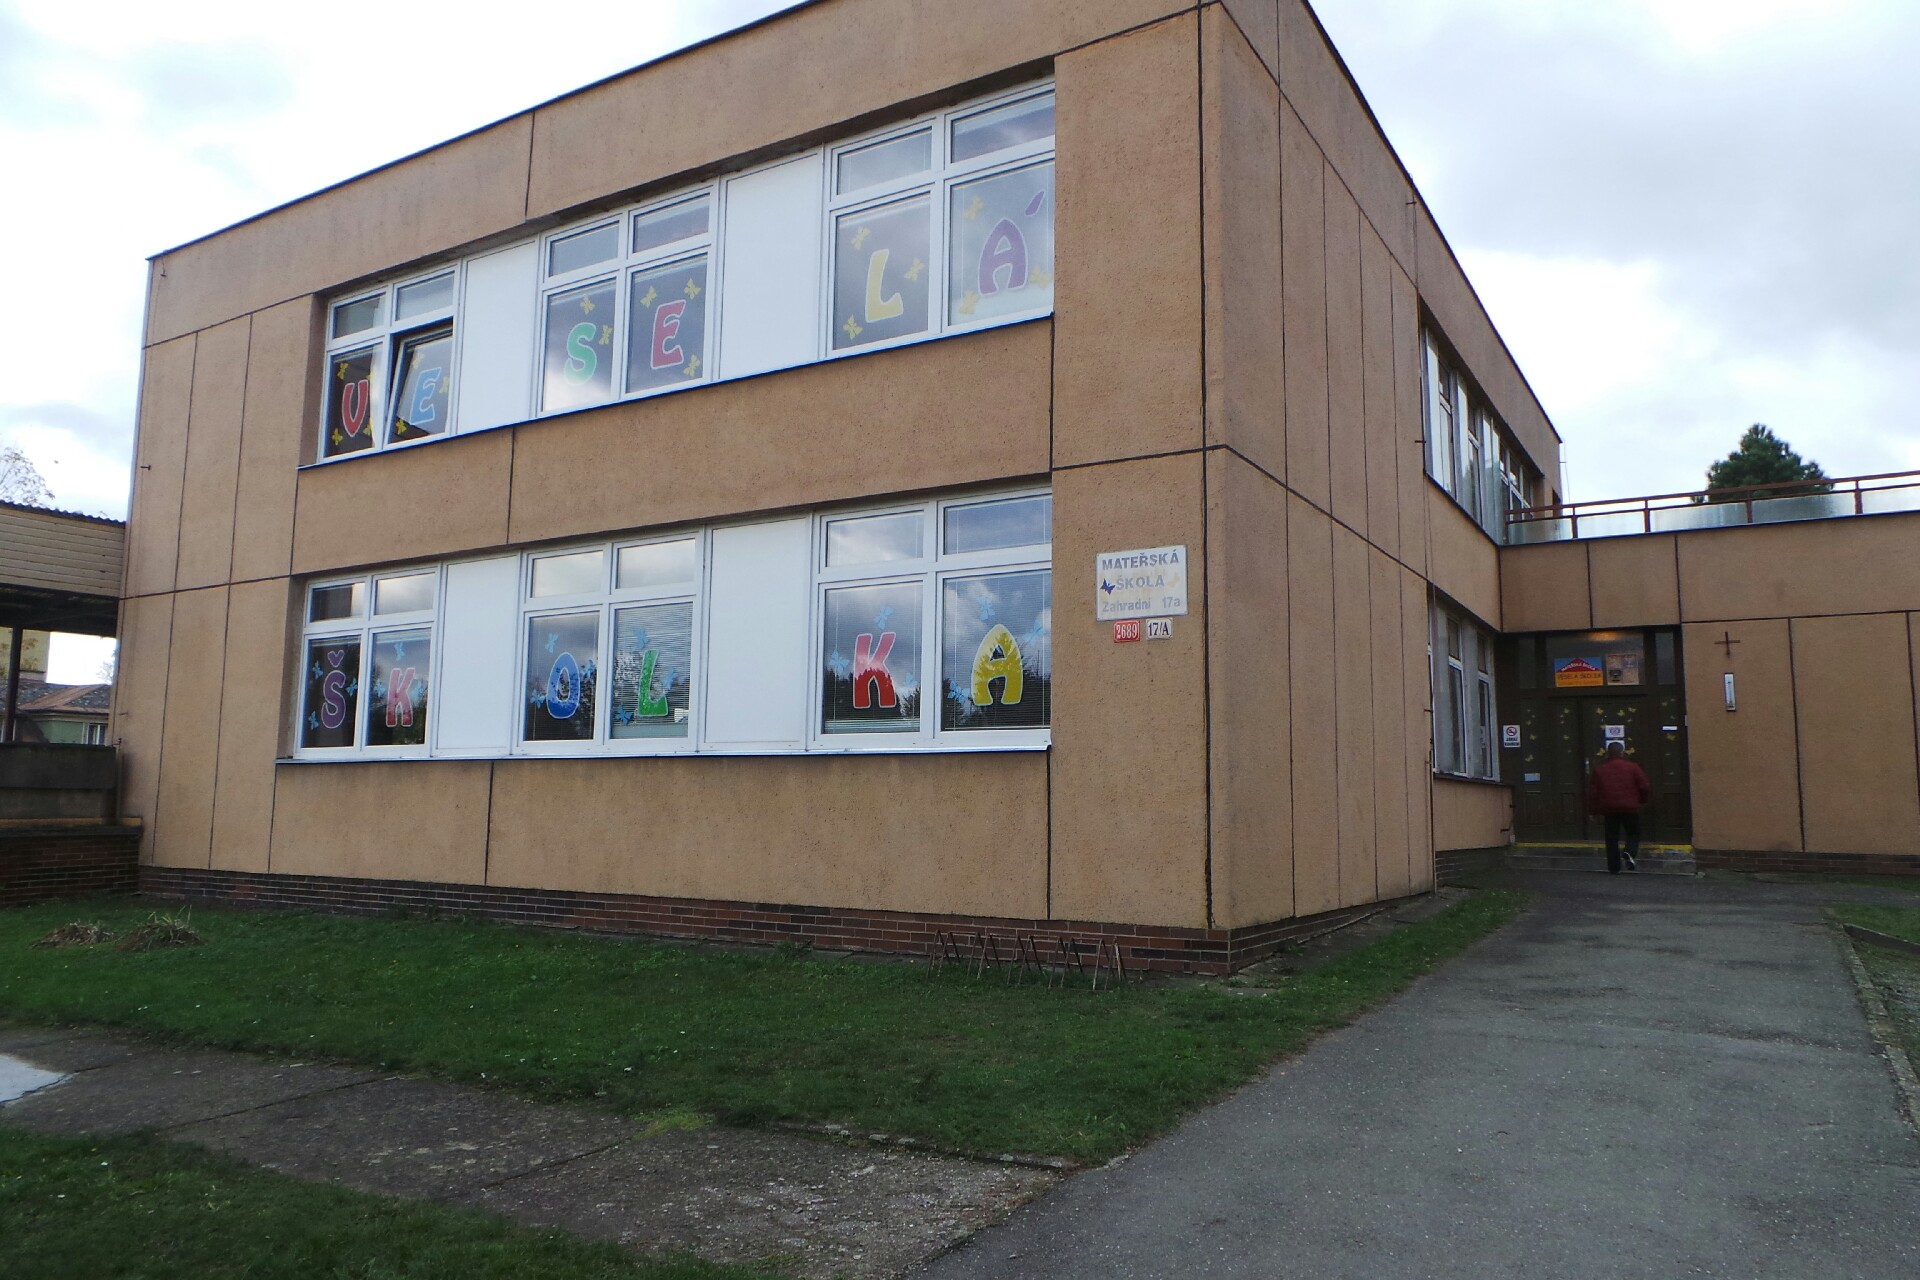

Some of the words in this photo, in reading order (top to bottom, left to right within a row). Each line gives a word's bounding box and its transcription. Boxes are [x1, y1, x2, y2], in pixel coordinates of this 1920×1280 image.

[341, 189, 1045, 438] VESELÁ
[1102, 549, 1179, 570] MATEŘSKÁ
[1116, 574, 1165, 591] ŠKOLA
[1162, 596, 1181, 609] 17a
[1116, 624, 1138, 639] 2689
[1148, 622, 1170, 637] 17/A
[320, 624, 1024, 729] ŠKOLKA
